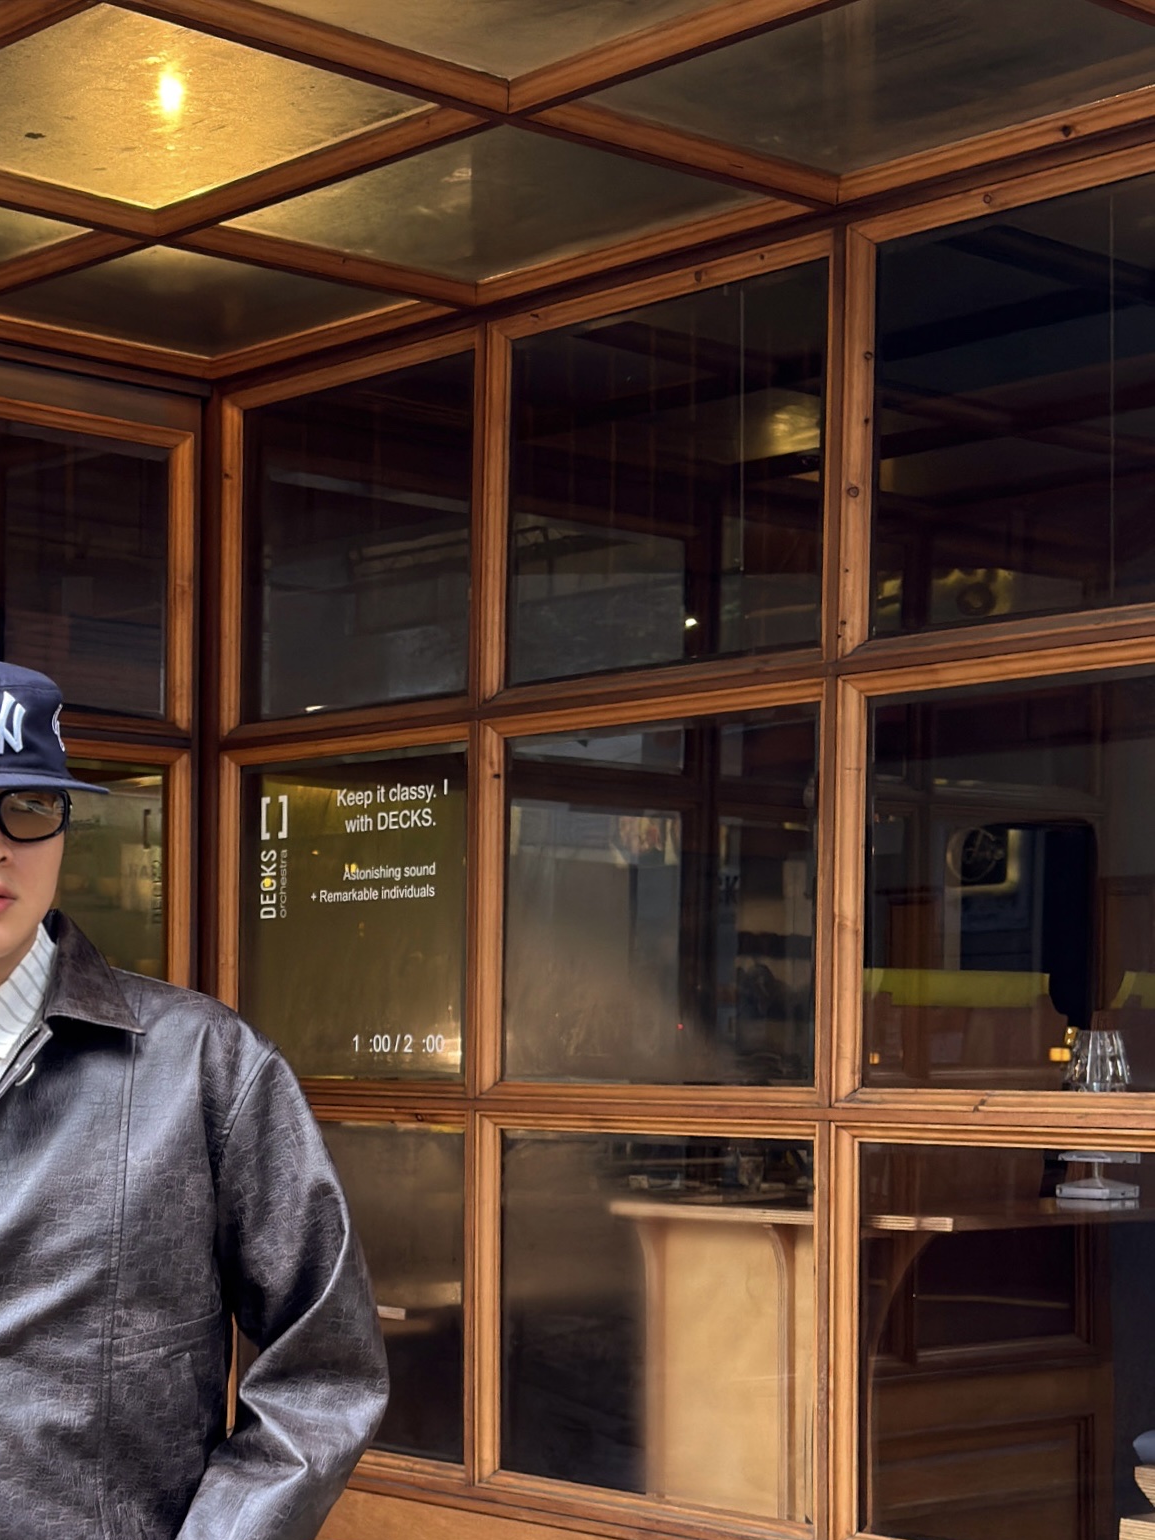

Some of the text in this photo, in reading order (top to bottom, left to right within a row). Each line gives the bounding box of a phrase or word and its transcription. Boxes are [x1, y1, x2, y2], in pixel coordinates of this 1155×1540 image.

[337, 788, 373, 809] Keep
[377, 784, 385, 803] it
[389, 783, 437, 803] classy.
[345, 808, 436, 833] with DECKS.
[259, 849, 277, 919] DECKS
[279, 849, 288, 919] orchestra
[343, 862, 436, 881] Astonishing sound
[319, 887, 379, 903] Remarkable
[381, 884, 436, 900] individuals
